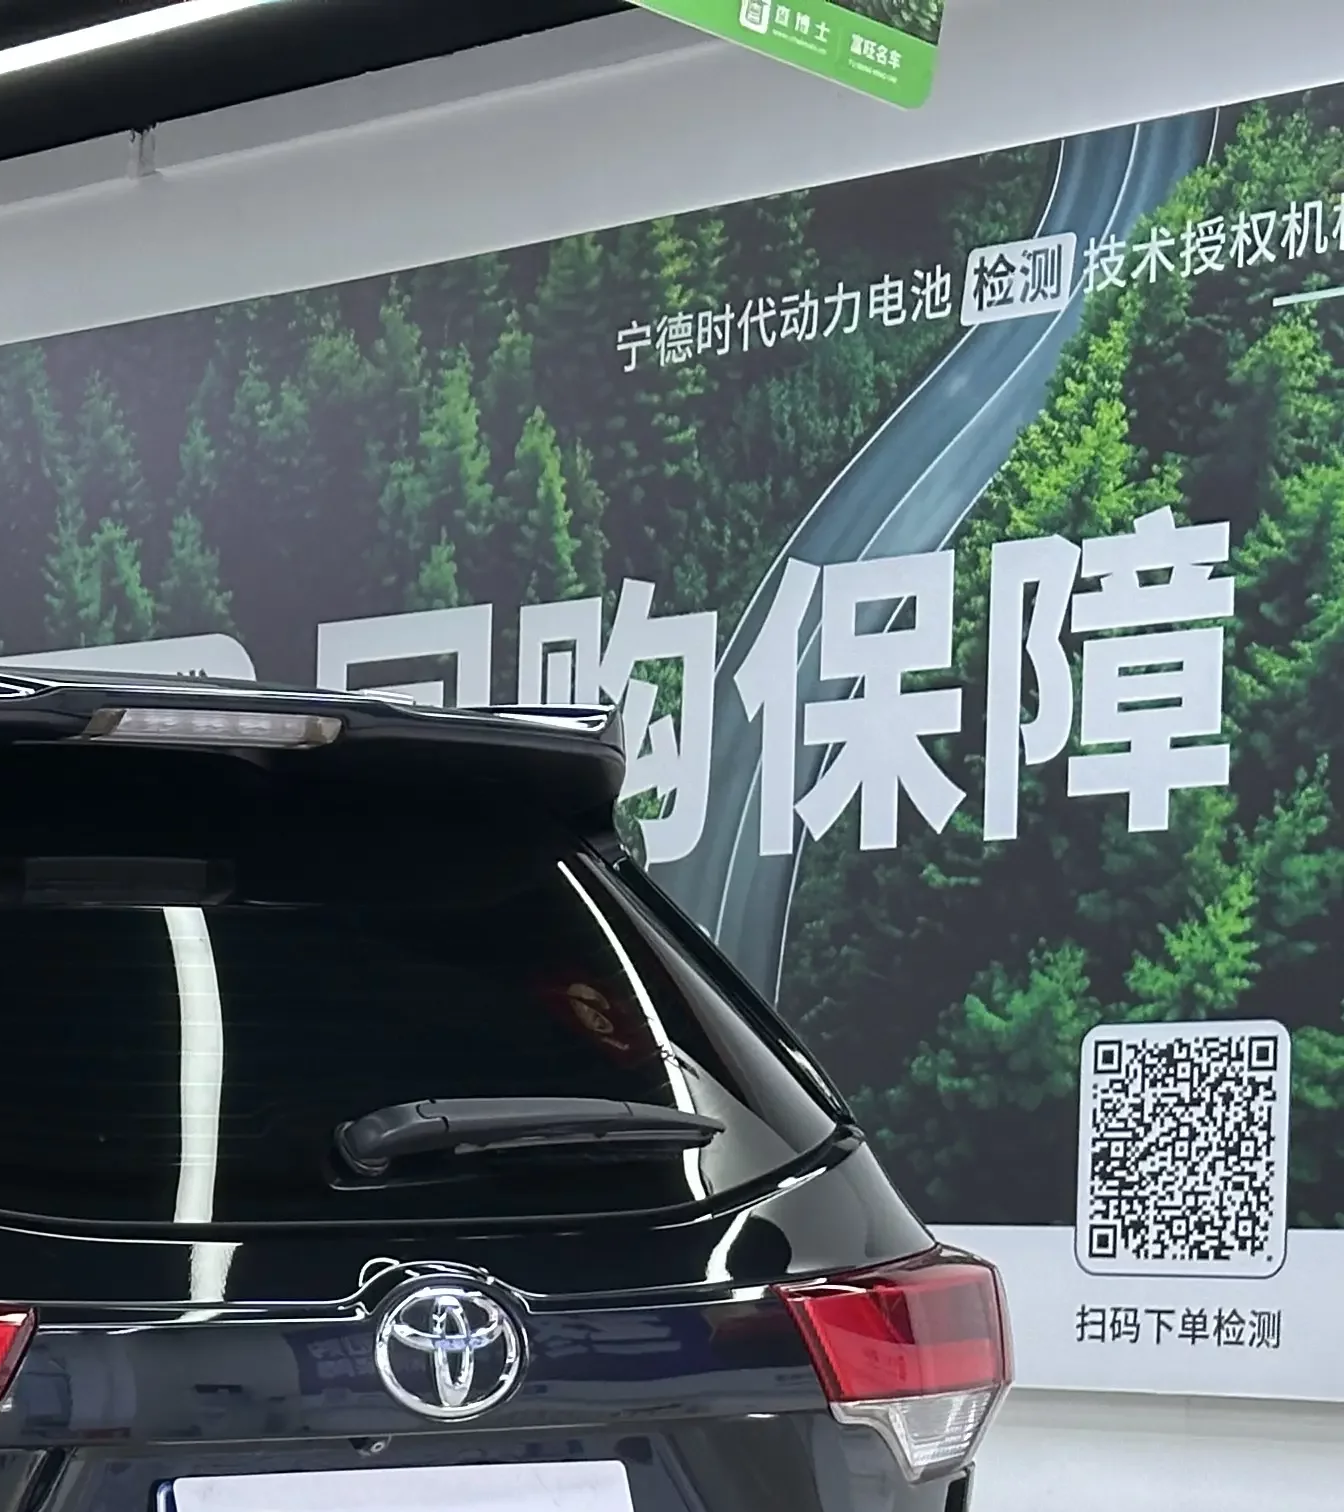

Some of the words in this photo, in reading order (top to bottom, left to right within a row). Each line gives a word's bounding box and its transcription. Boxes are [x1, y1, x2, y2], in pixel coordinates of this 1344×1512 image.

[616, 264, 952, 373] 宁德时代动力电池
[973, 243, 1064, 313] 检测
[1082, 192, 1344, 295] 技术授权机
[1075, 1304, 1283, 1349] 扫码下单检测
